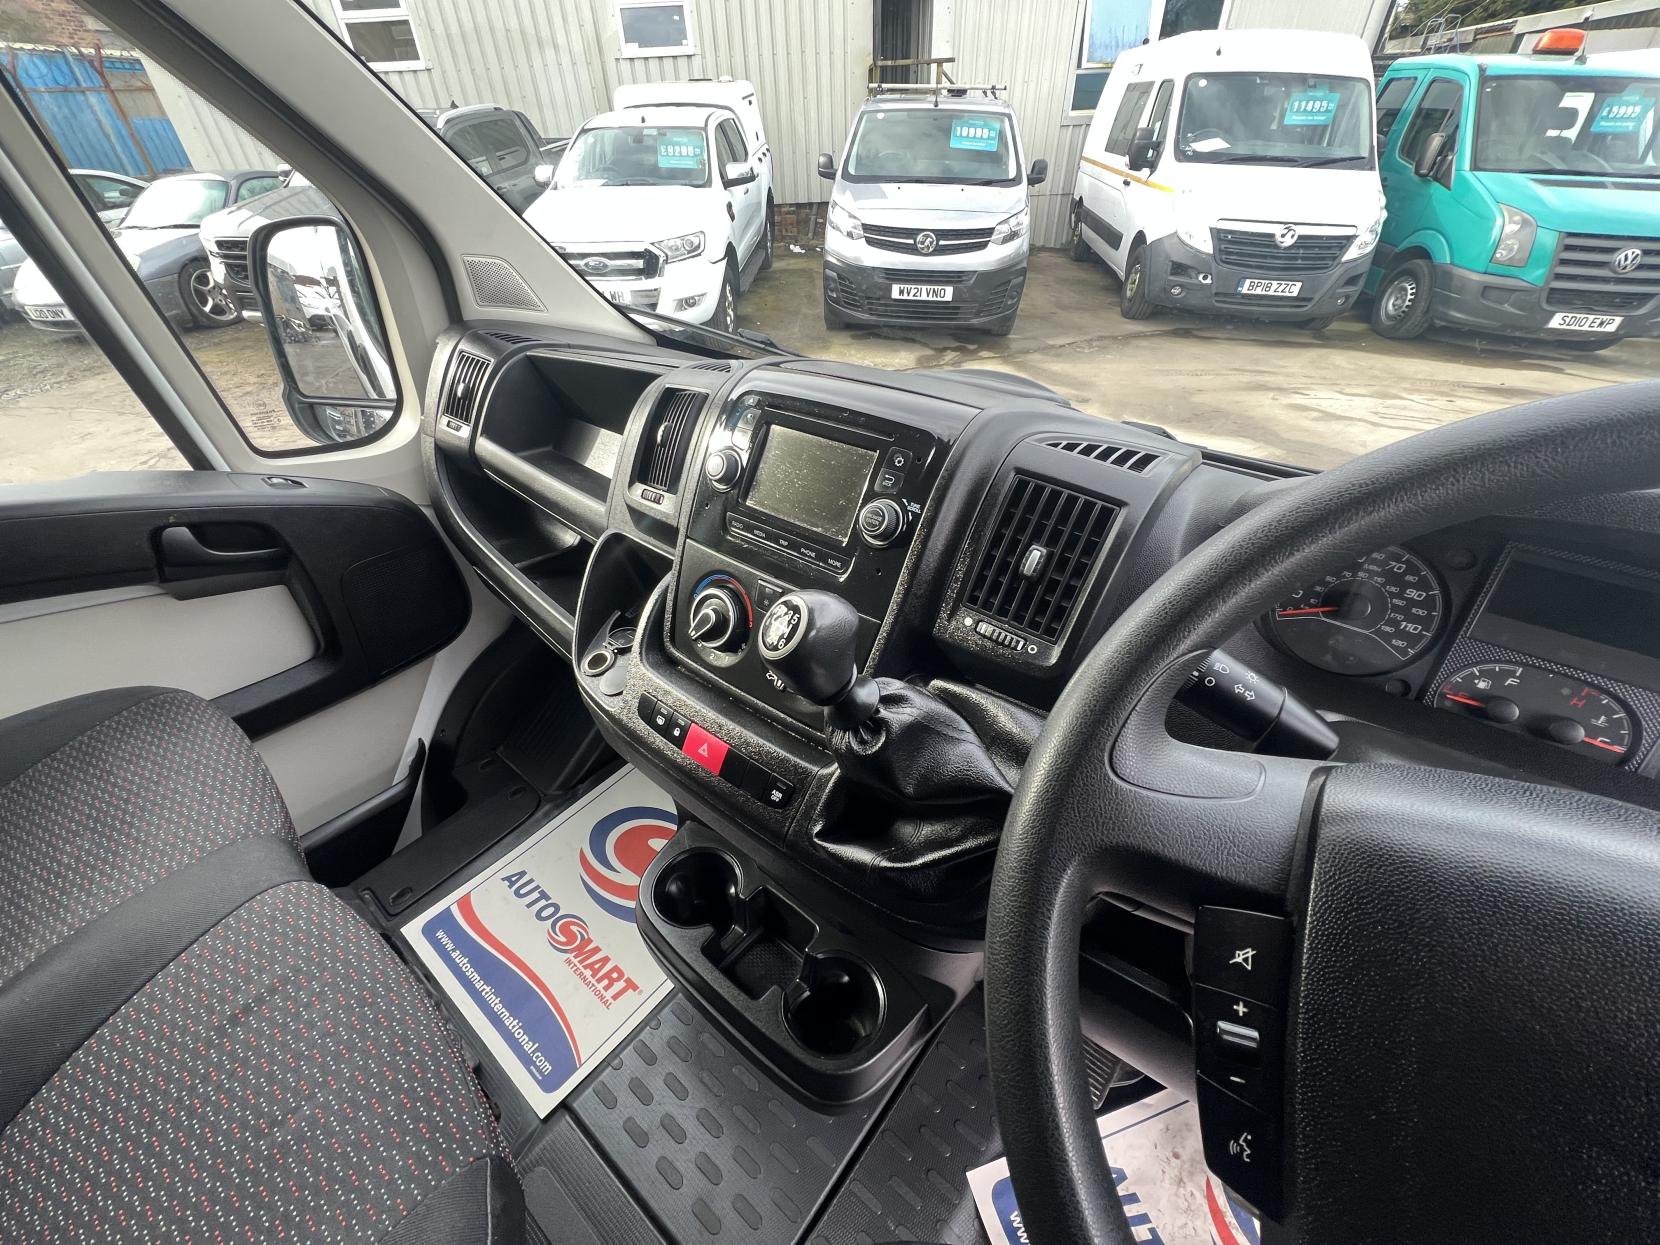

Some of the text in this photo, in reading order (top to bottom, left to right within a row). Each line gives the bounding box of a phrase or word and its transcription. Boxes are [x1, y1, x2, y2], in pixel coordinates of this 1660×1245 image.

[898, 286, 946, 299] WV21 VNO
[1247, 280, 1297, 294] BP18 ZZC
[1558, 315, 1616, 329] SD10 EWP
[800, 547, 816, 558] PHONE
[828, 558, 842, 568] MORE
[1385, 561, 1406, 573] 70
[1404, 588, 1426, 601] 90
[1411, 607, 1427, 616] 100
[790, 613, 801, 624] 5
[1400, 621, 1422, 634] 110
[777, 638, 786, 650] 6
[1504, 677, 1521, 687] F
[563, 956, 614, 1010] INTERNATIONAL
[435, 928, 552, 1076] www.autosmartinternational.com
